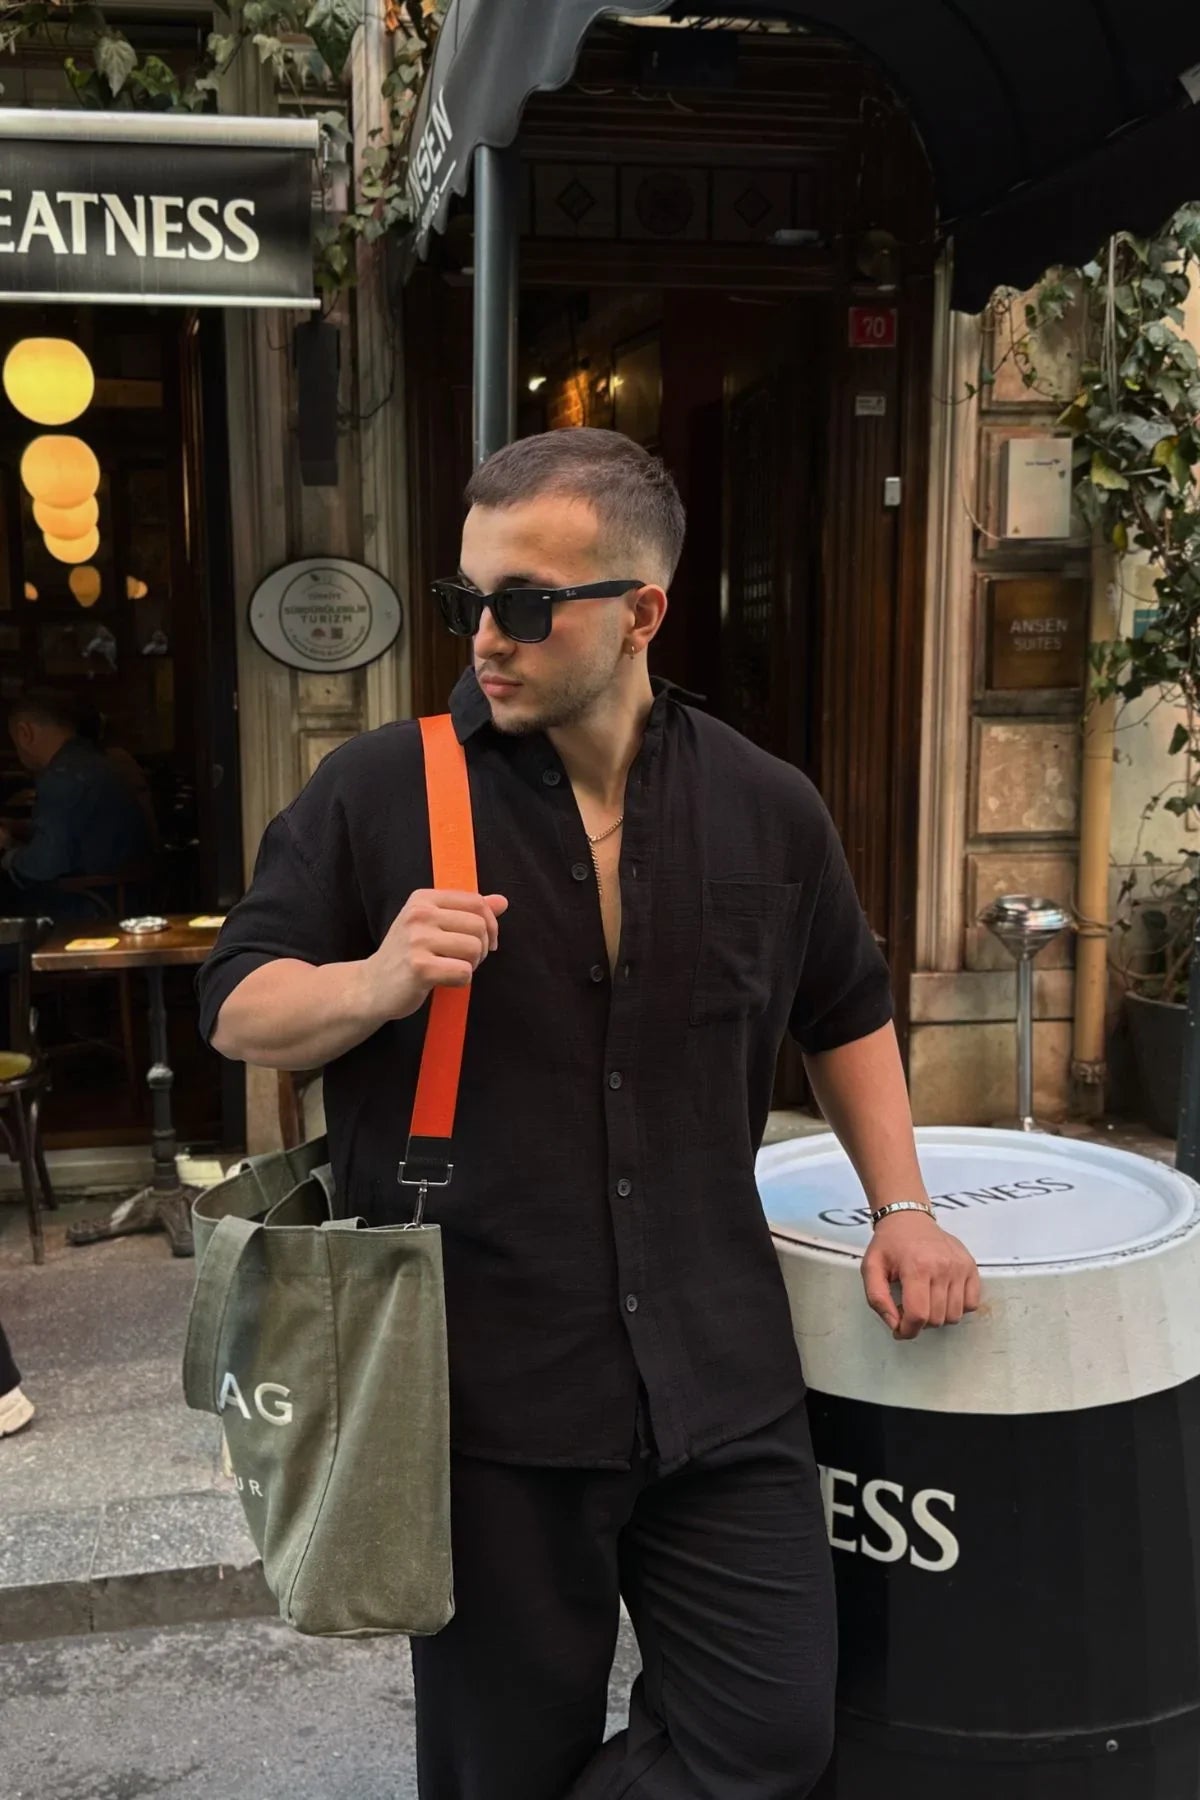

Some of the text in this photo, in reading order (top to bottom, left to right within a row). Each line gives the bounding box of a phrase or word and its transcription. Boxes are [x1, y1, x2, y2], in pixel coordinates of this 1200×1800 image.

[405, 86, 453, 222] NSEN
[862, 316, 886, 339] 70
[1009, 618, 1069, 634] ANSEN
[1013, 636, 1062, 651] SUITES
[817, 1176, 1075, 1228] GTNESS
[816, 1463, 960, 1573] ESS
